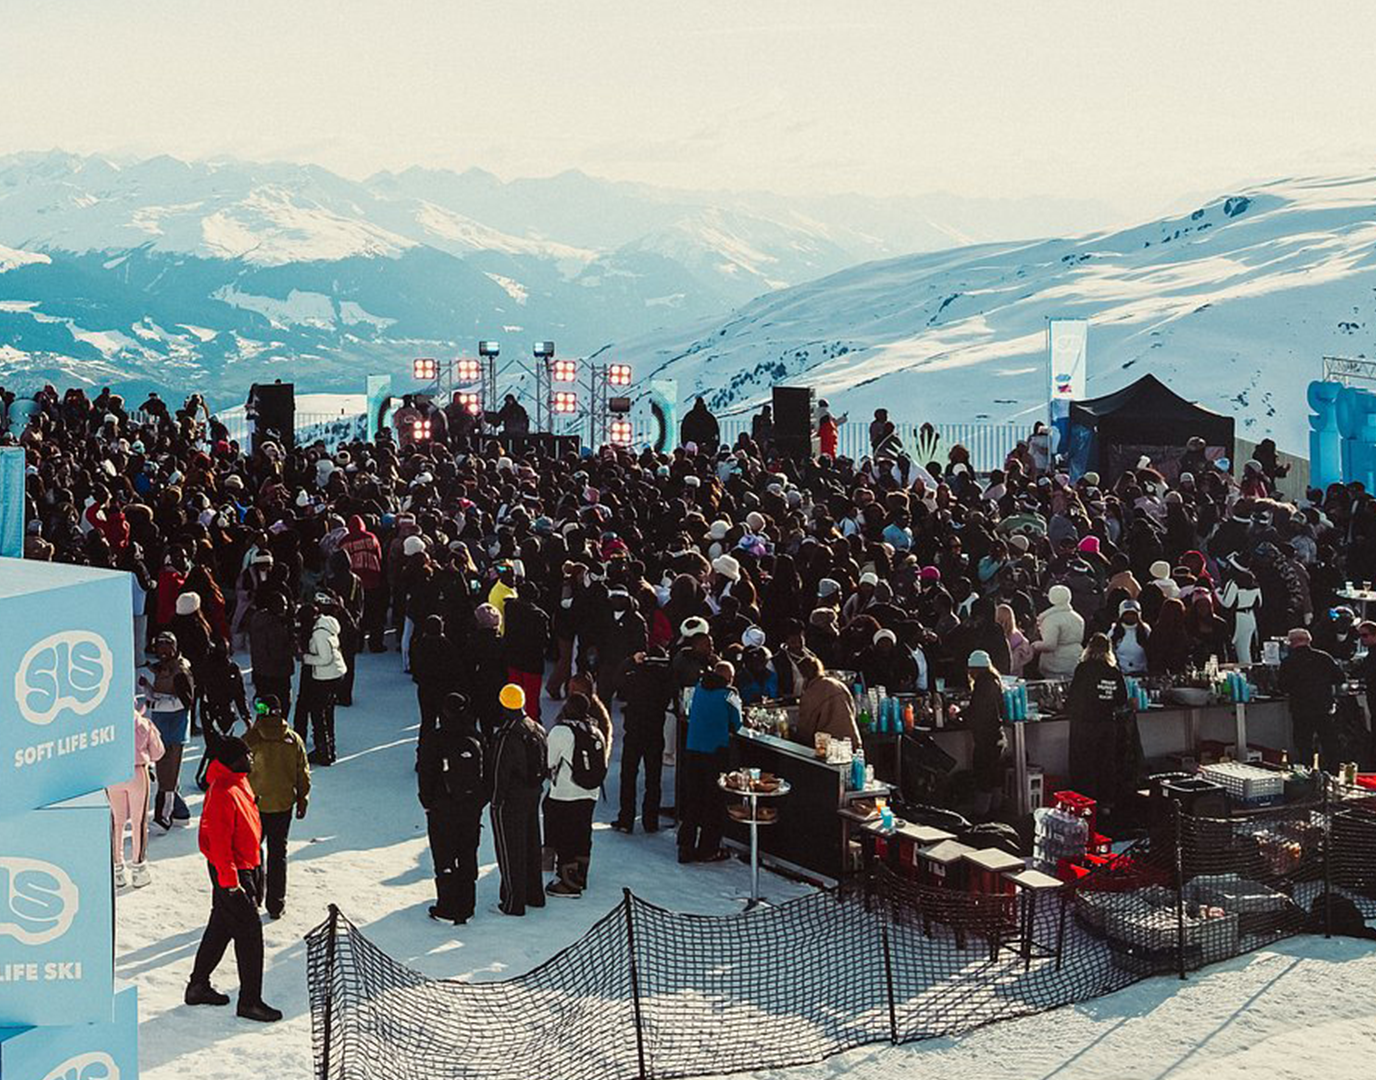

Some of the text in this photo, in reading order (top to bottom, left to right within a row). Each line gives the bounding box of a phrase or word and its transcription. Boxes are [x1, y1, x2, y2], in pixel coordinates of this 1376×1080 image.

[24, 638, 103, 716] SLS
[14, 725, 115, 768] SOFT LIFE SKI
[45, 962, 82, 981] SKI
